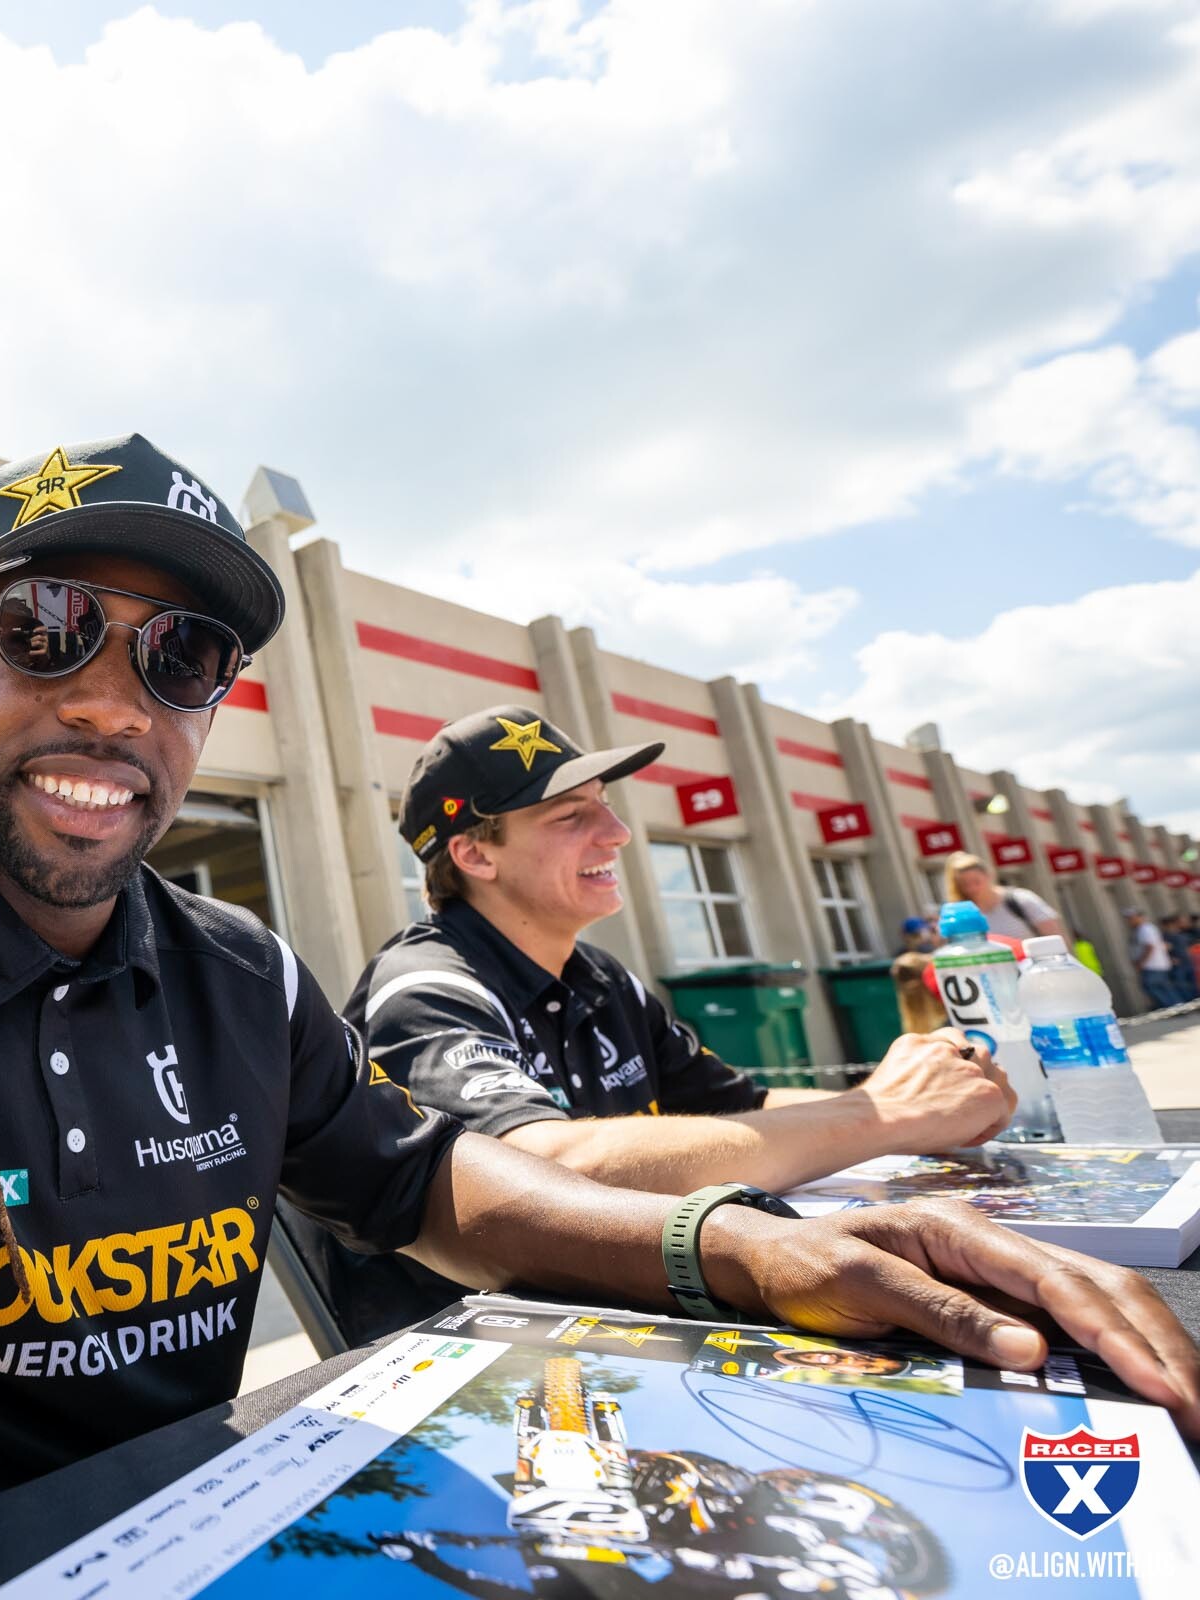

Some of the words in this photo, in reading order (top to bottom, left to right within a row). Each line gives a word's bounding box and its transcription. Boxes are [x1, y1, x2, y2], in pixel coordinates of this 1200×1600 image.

[691, 789, 723, 811] 29
[832, 813, 858, 831] 31
[215, 1147, 247, 1166] RACING
[118, 1298, 238, 1367] DRINK
